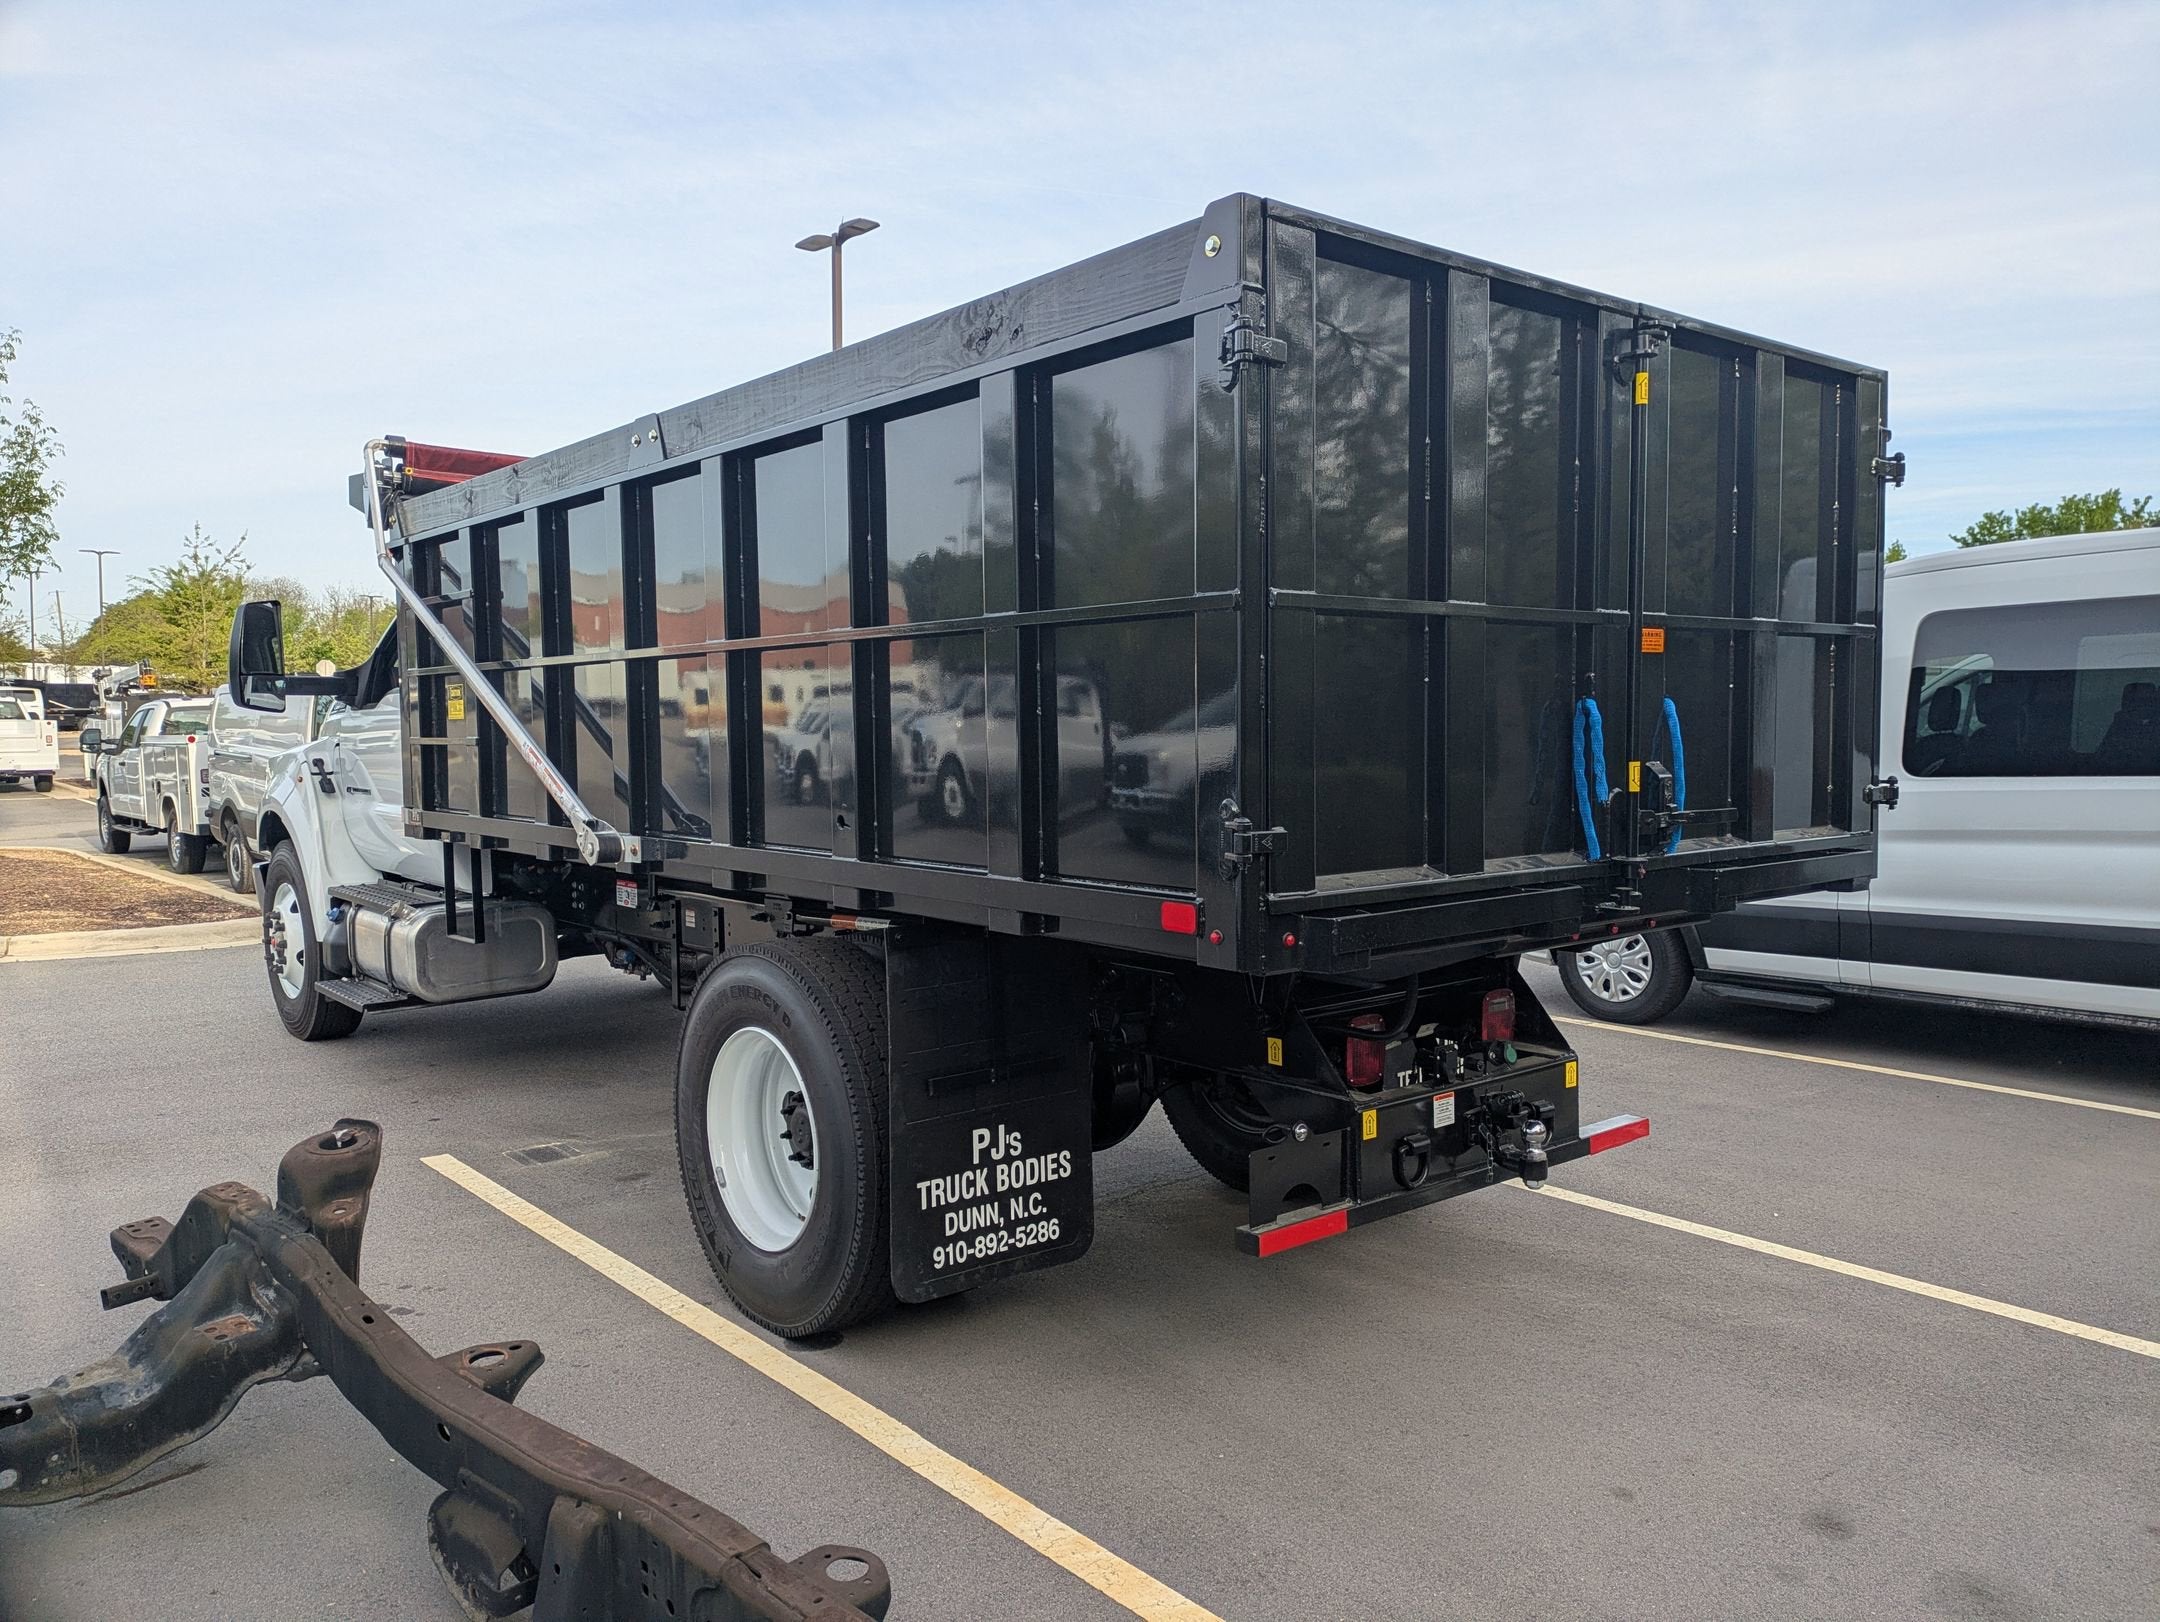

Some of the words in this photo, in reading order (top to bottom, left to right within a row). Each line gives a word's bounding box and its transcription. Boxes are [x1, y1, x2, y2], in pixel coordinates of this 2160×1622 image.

[916, 1167, 990, 1210] TRUCK
[996, 1150, 1072, 1193] BODIES
[944, 1202, 1004, 1237] DUNN,
[1010, 1192, 1047, 1221] N.C.
[932, 1218, 1060, 1270] 910-892-5286
